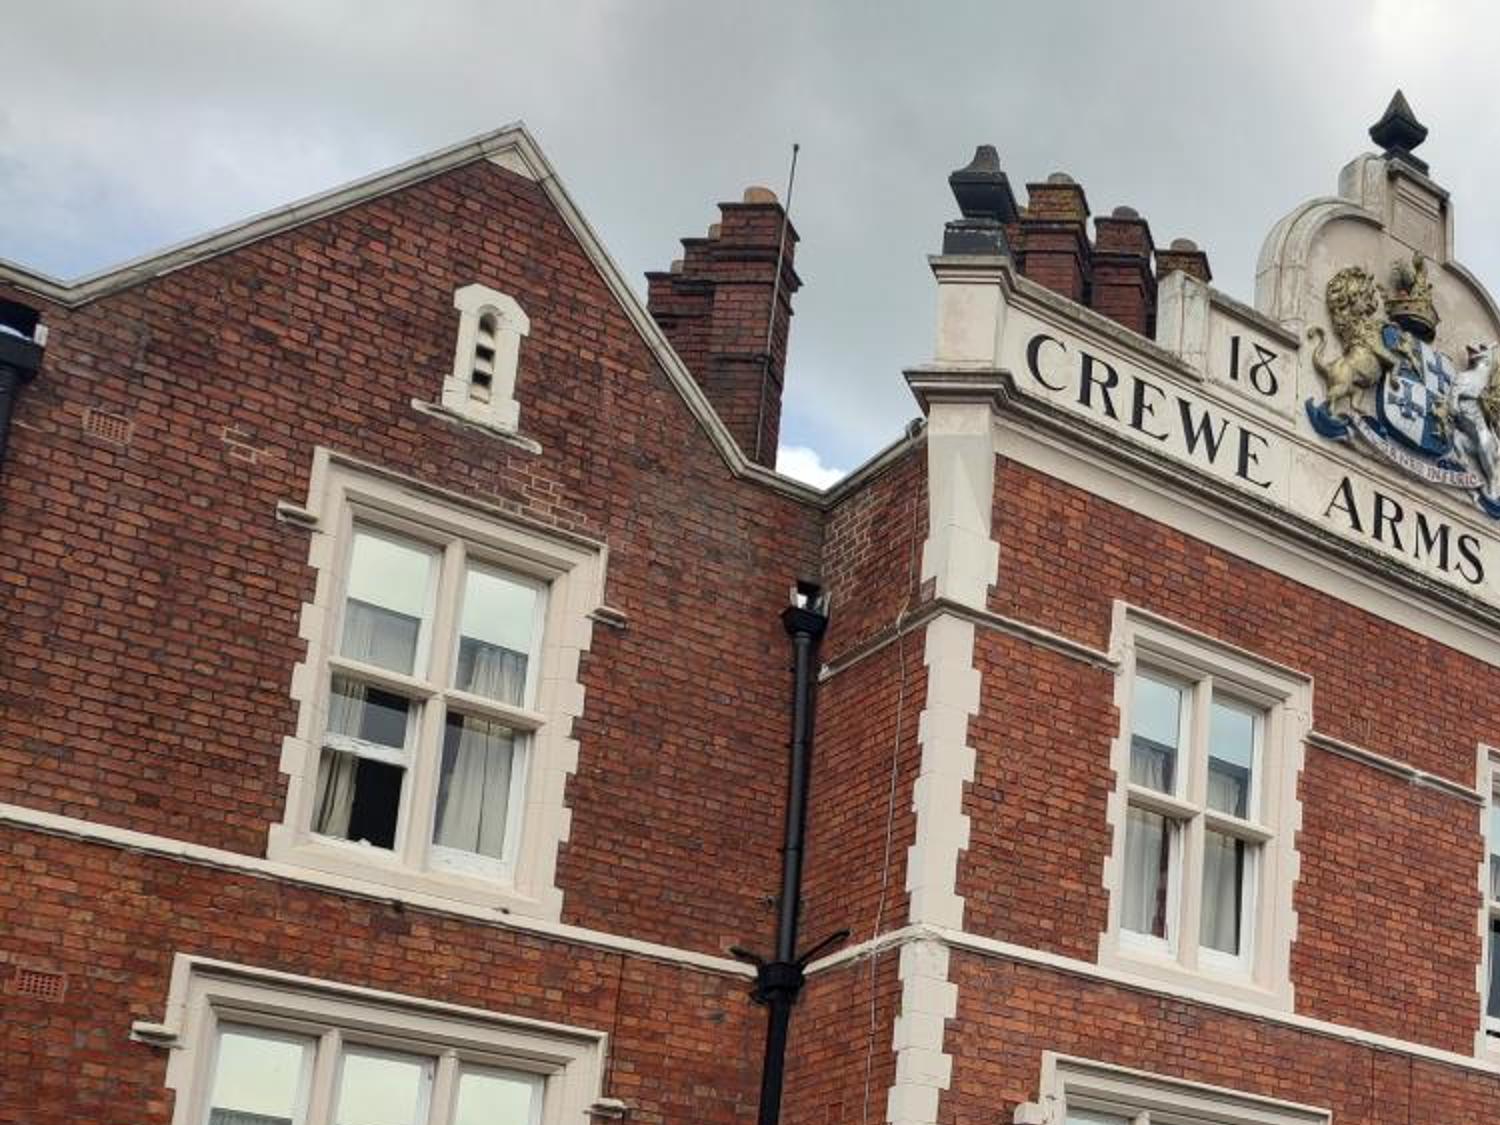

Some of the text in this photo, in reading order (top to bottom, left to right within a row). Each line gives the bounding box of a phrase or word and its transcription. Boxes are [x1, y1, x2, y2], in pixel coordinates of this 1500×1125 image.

[1229, 335, 1279, 396] 18
[1025, 333, 1272, 489] CREWE
[1323, 476, 1485, 585] ARMS
